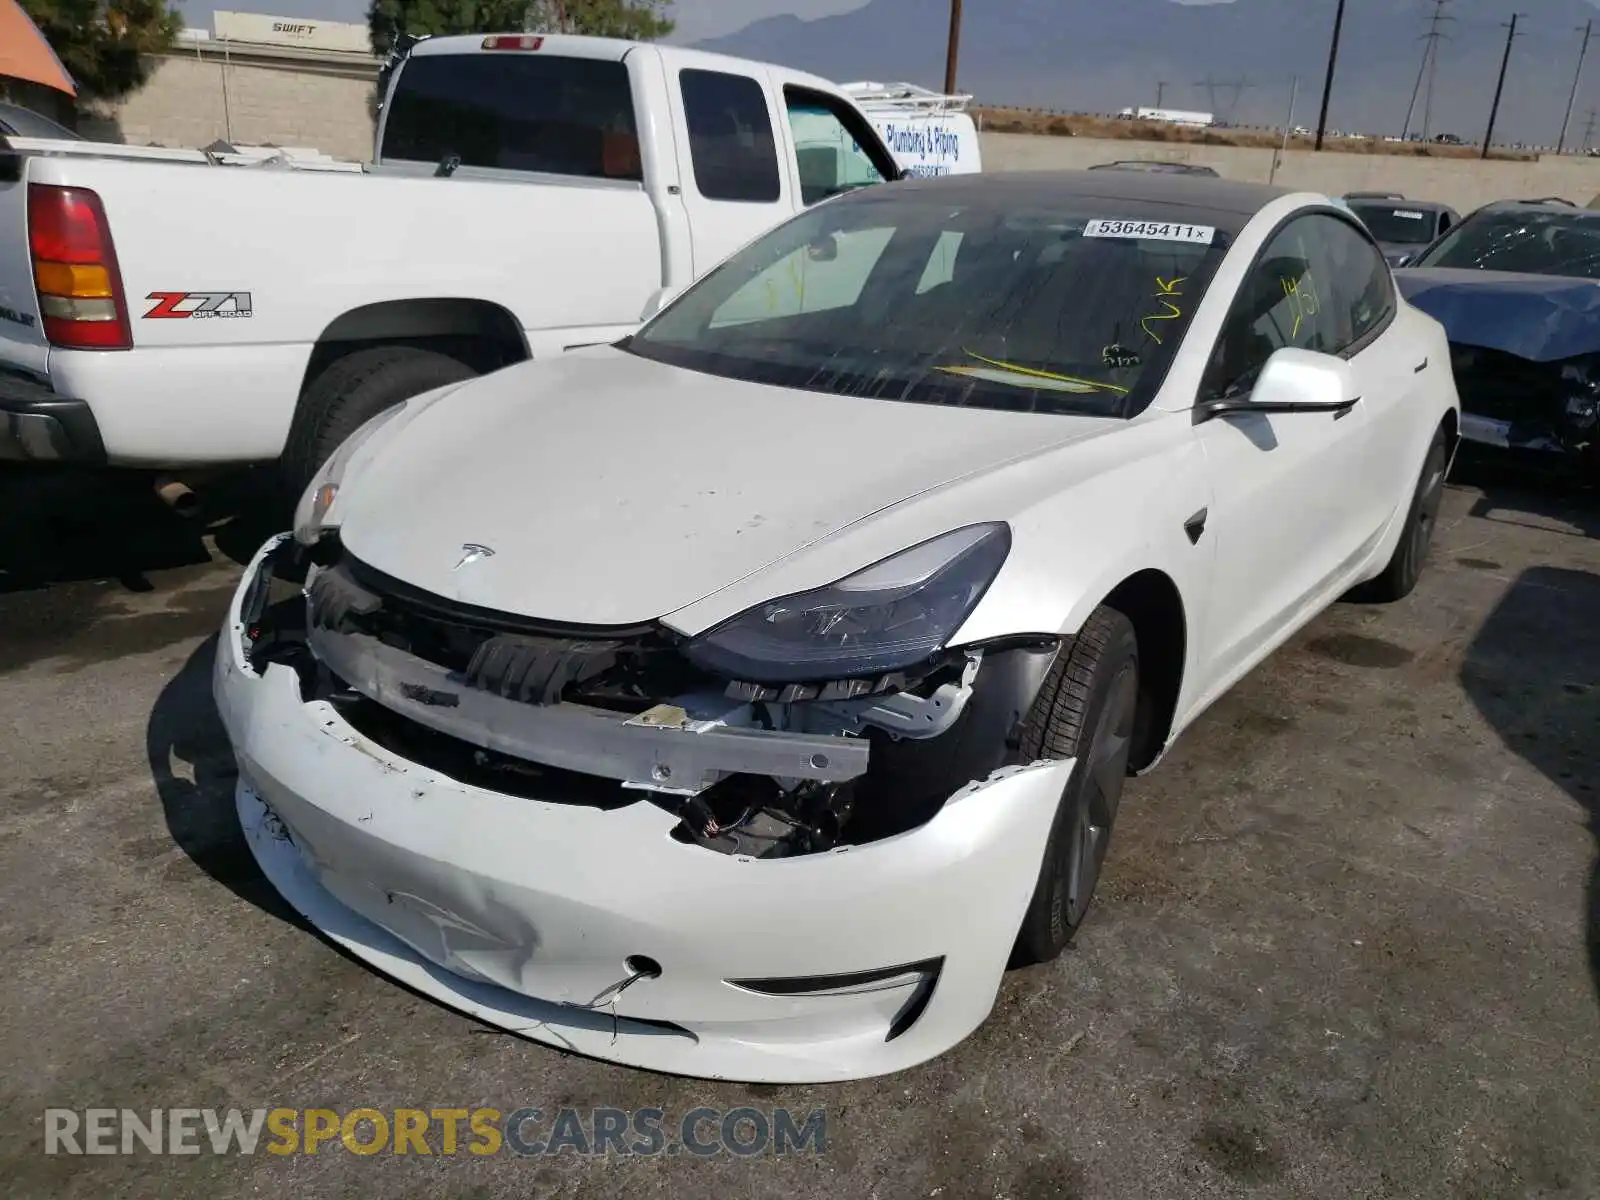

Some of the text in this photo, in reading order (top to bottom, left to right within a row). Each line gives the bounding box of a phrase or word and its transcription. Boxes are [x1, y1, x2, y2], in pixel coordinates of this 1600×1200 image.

[272, 22, 317, 35] SWIFT
[887, 123, 926, 161] Plumbing
[927, 125, 933, 153] &
[934, 127, 959, 162] Piping
[141, 291, 252, 319] Z71
